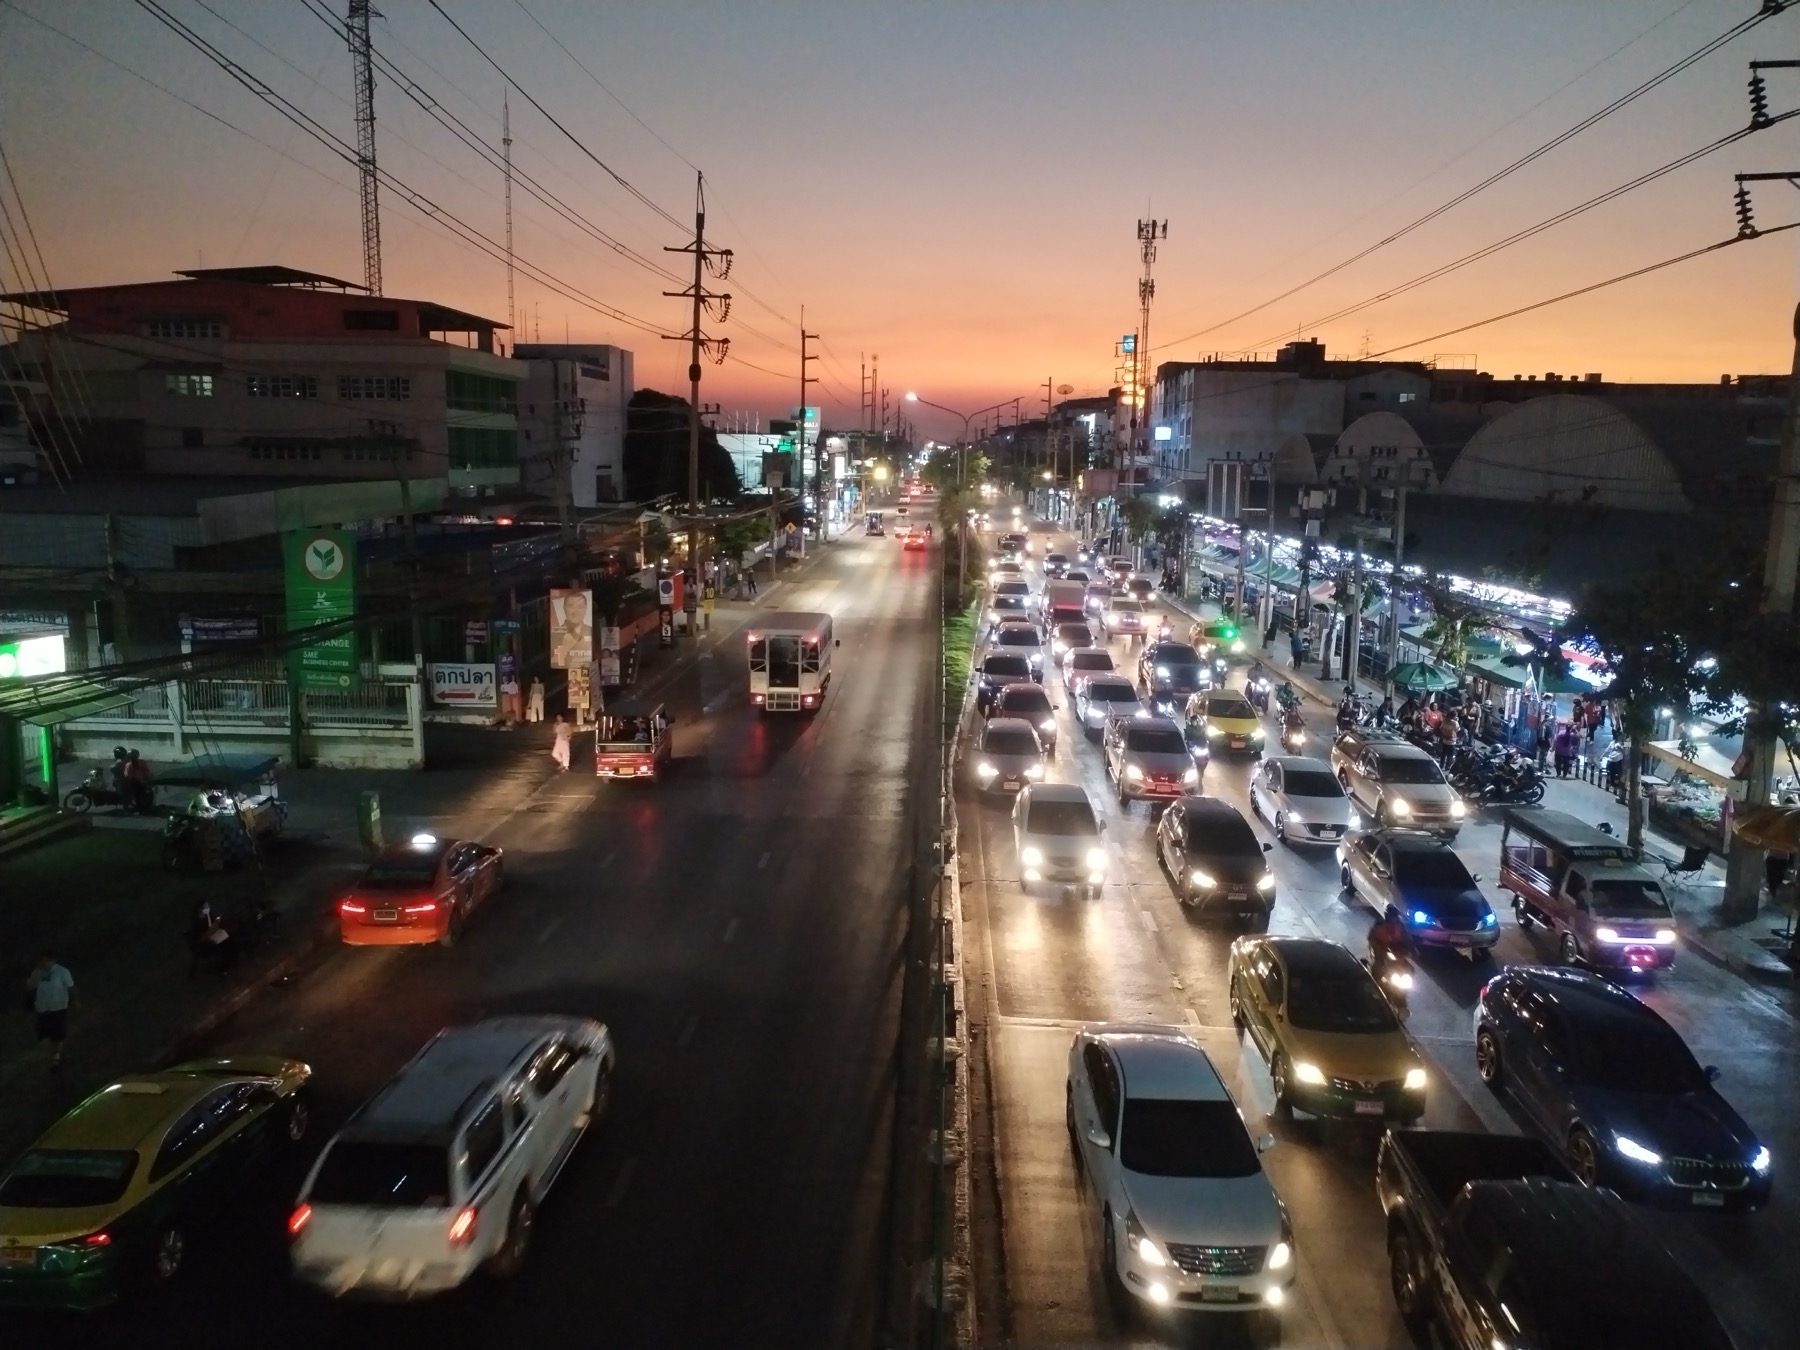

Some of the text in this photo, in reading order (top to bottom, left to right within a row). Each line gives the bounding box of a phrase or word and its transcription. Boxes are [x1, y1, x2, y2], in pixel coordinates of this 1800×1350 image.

[705, 587, 715, 598] 10
[302, 651, 319, 659] SME
[435, 668, 493, 684] ตกปลา
